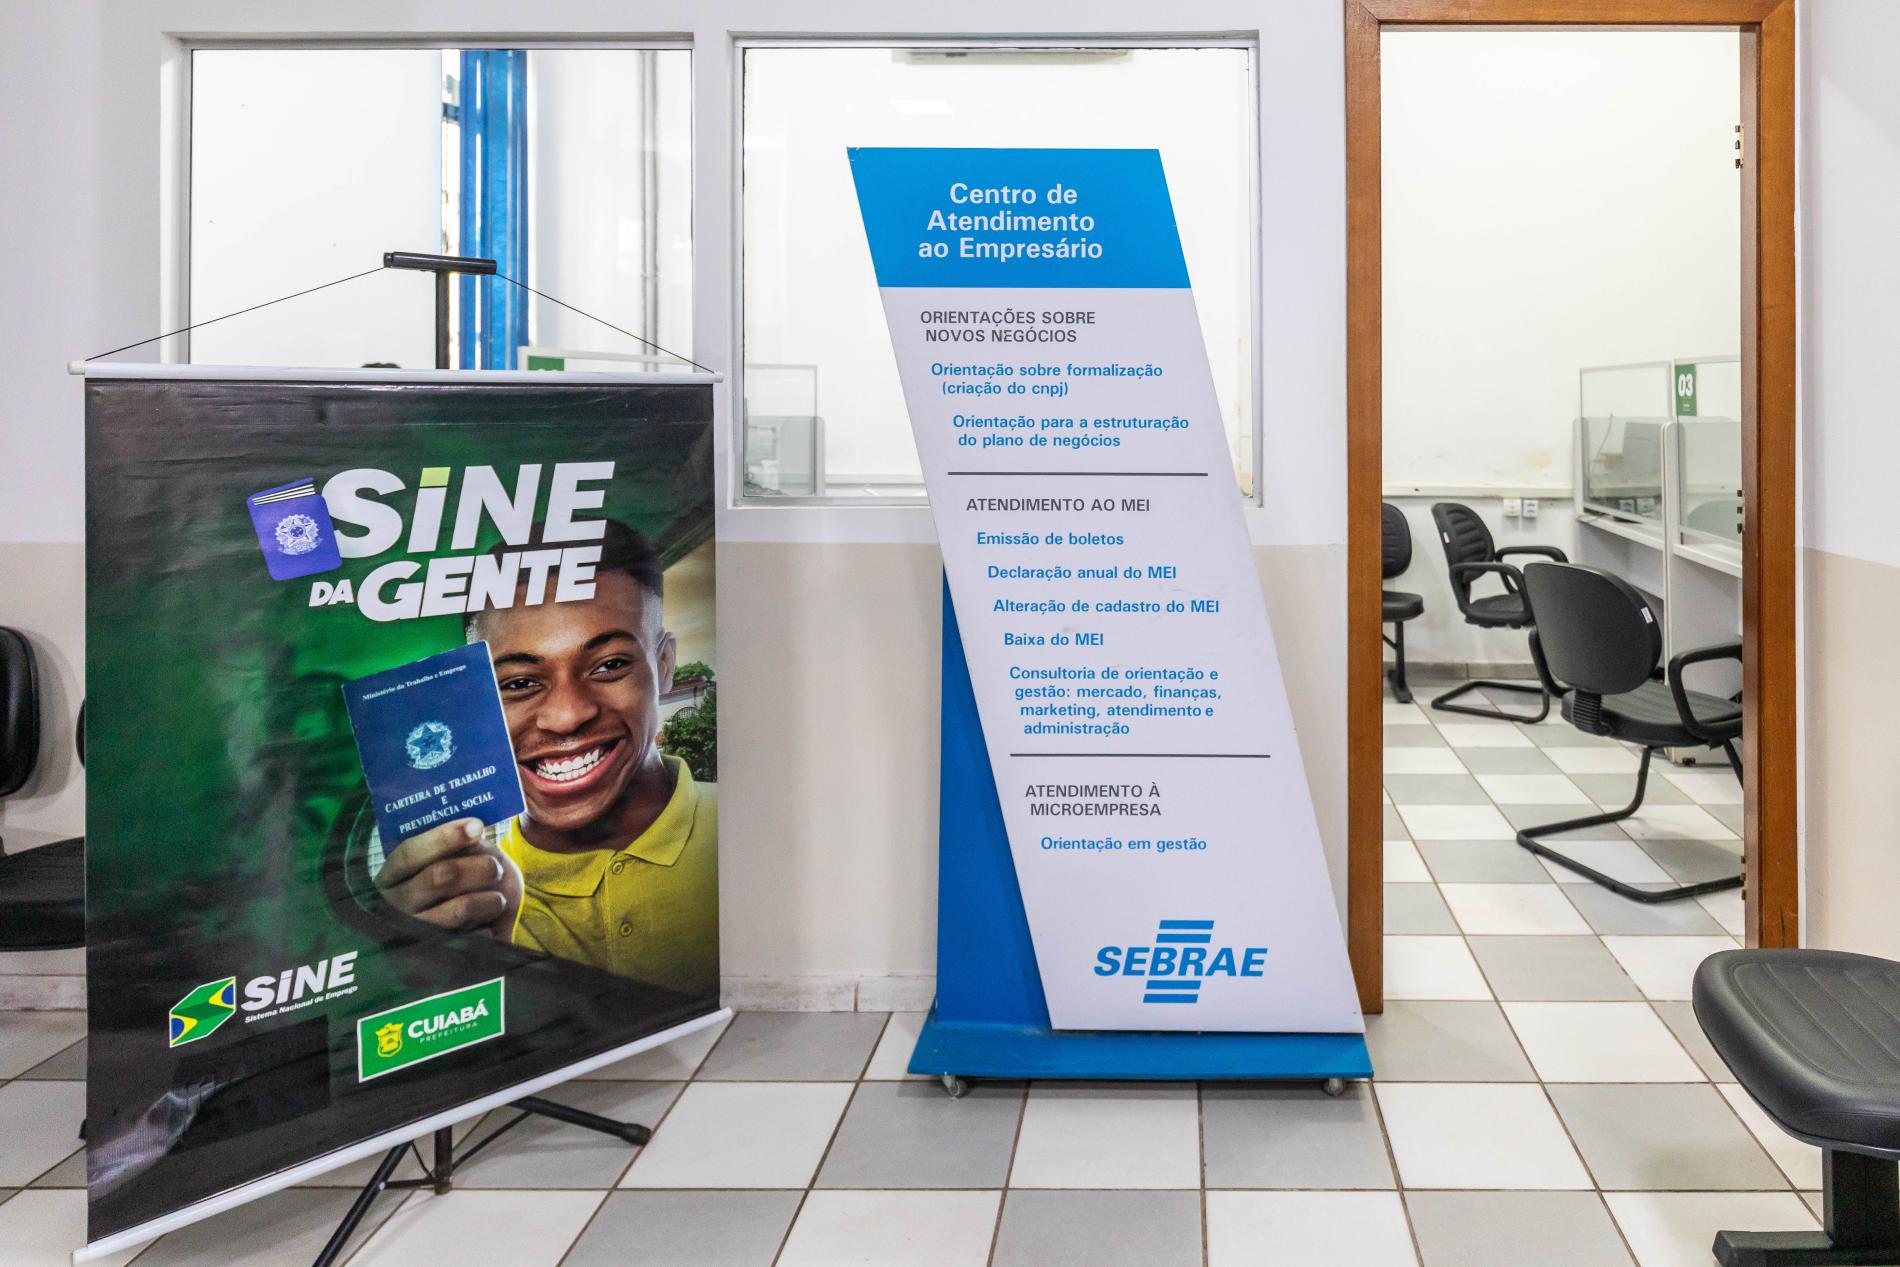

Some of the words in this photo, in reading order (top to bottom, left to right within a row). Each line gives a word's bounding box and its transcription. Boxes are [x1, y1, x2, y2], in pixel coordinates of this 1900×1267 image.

[950, 183, 1036, 204] Centro
[1047, 184, 1077, 204] de
[928, 210, 1094, 231] Atendimento
[919, 243, 948, 258] ao
[960, 238, 1102, 262] Empresário
[921, 308, 1035, 329] ORIENTAÇÕES
[1042, 312, 1095, 325] SOBRE
[926, 330, 985, 342] NOVOS
[992, 326, 1076, 342] NEGÓCIOS
[932, 363, 1013, 380] Orientação
[1020, 364, 1061, 376] sobre
[1067, 364, 1162, 380] formalização
[943, 382, 1001, 398] (criação
[1008, 382, 1026, 395] do
[1032, 382, 1068, 398] cnpj)
[1678, 373, 1694, 397] 03
[953, 415, 1035, 431] Orientação
[1041, 418, 1073, 431] para
[1080, 418, 1088, 429] a
[1094, 415, 1189, 431] estruturação
[958, 434, 976, 446] do
[983, 434, 1023, 449] plano
[1029, 434, 1047, 447] de
[1053, 433, 1121, 449] negócios
[967, 499, 1084, 512] ATENDIMENTO
[1091, 499, 1115, 512] AO
[1122, 499, 1150, 512] MEI
[977, 532, 1039, 545] Emissão
[1045, 532, 1063, 545] de
[1069, 532, 1124, 545] boletos
[988, 566, 1072, 582] Declaração
[1077, 566, 1118, 579] anual
[1124, 566, 1142, 579] do
[1148, 566, 1177, 579] MEI
[308, 579, 353, 608] DA
[356, 546, 602, 622] GENTE
[993, 599, 1066, 615] Alteração
[1072, 600, 1090, 613] de
[1096, 600, 1160, 613] cadastro
[1166, 600, 1185, 613] do
[1191, 600, 1219, 613] MEI
[1004, 633, 1045, 646] Baixa
[1051, 633, 1069, 646] do
[1075, 633, 1104, 646] MEI
[1010, 666, 1095, 680] Consultoria
[1101, 667, 1119, 680] de
[1125, 667, 1204, 683] orientação
[1210, 671, 1219, 680] e
[1015, 685, 1070, 701] gestão:
[1077, 685, 1147, 700] mercado,
[1154, 685, 1221, 701] finanças,
[1020, 704, 1100, 720] marketing,
[1107, 704, 1201, 717] atendimento
[1205, 707, 1214, 717] e
[1024, 722, 1130, 738] administração
[384, 789, 432, 813] CARTEIRA
[433, 783, 447, 796] DE
[448, 765, 497, 790] TRABALHO
[1025, 784, 1143, 798] ATENDIMENTO
[1149, 782, 1160, 798] À
[441, 795, 449, 806] E
[399, 804, 460, 834] PREVIDÊNCIA
[461, 791, 495, 810] SOCIAL
[1030, 803, 1161, 816] MICROEMPRESA
[1041, 837, 1122, 853] Orientação
[1128, 840, 1151, 850] em
[1157, 837, 1207, 853] gestão
[1094, 946, 1268, 977] SEBRAE
[244, 1009, 278, 1024] Sistema
[279, 998, 314, 1014] Nacional
[314, 995, 325, 1004] de
[325, 985, 359, 1001] Emprego
[407, 998, 489, 1039] CUIABÁ
[420, 1021, 478, 1043] PREFEITURA
